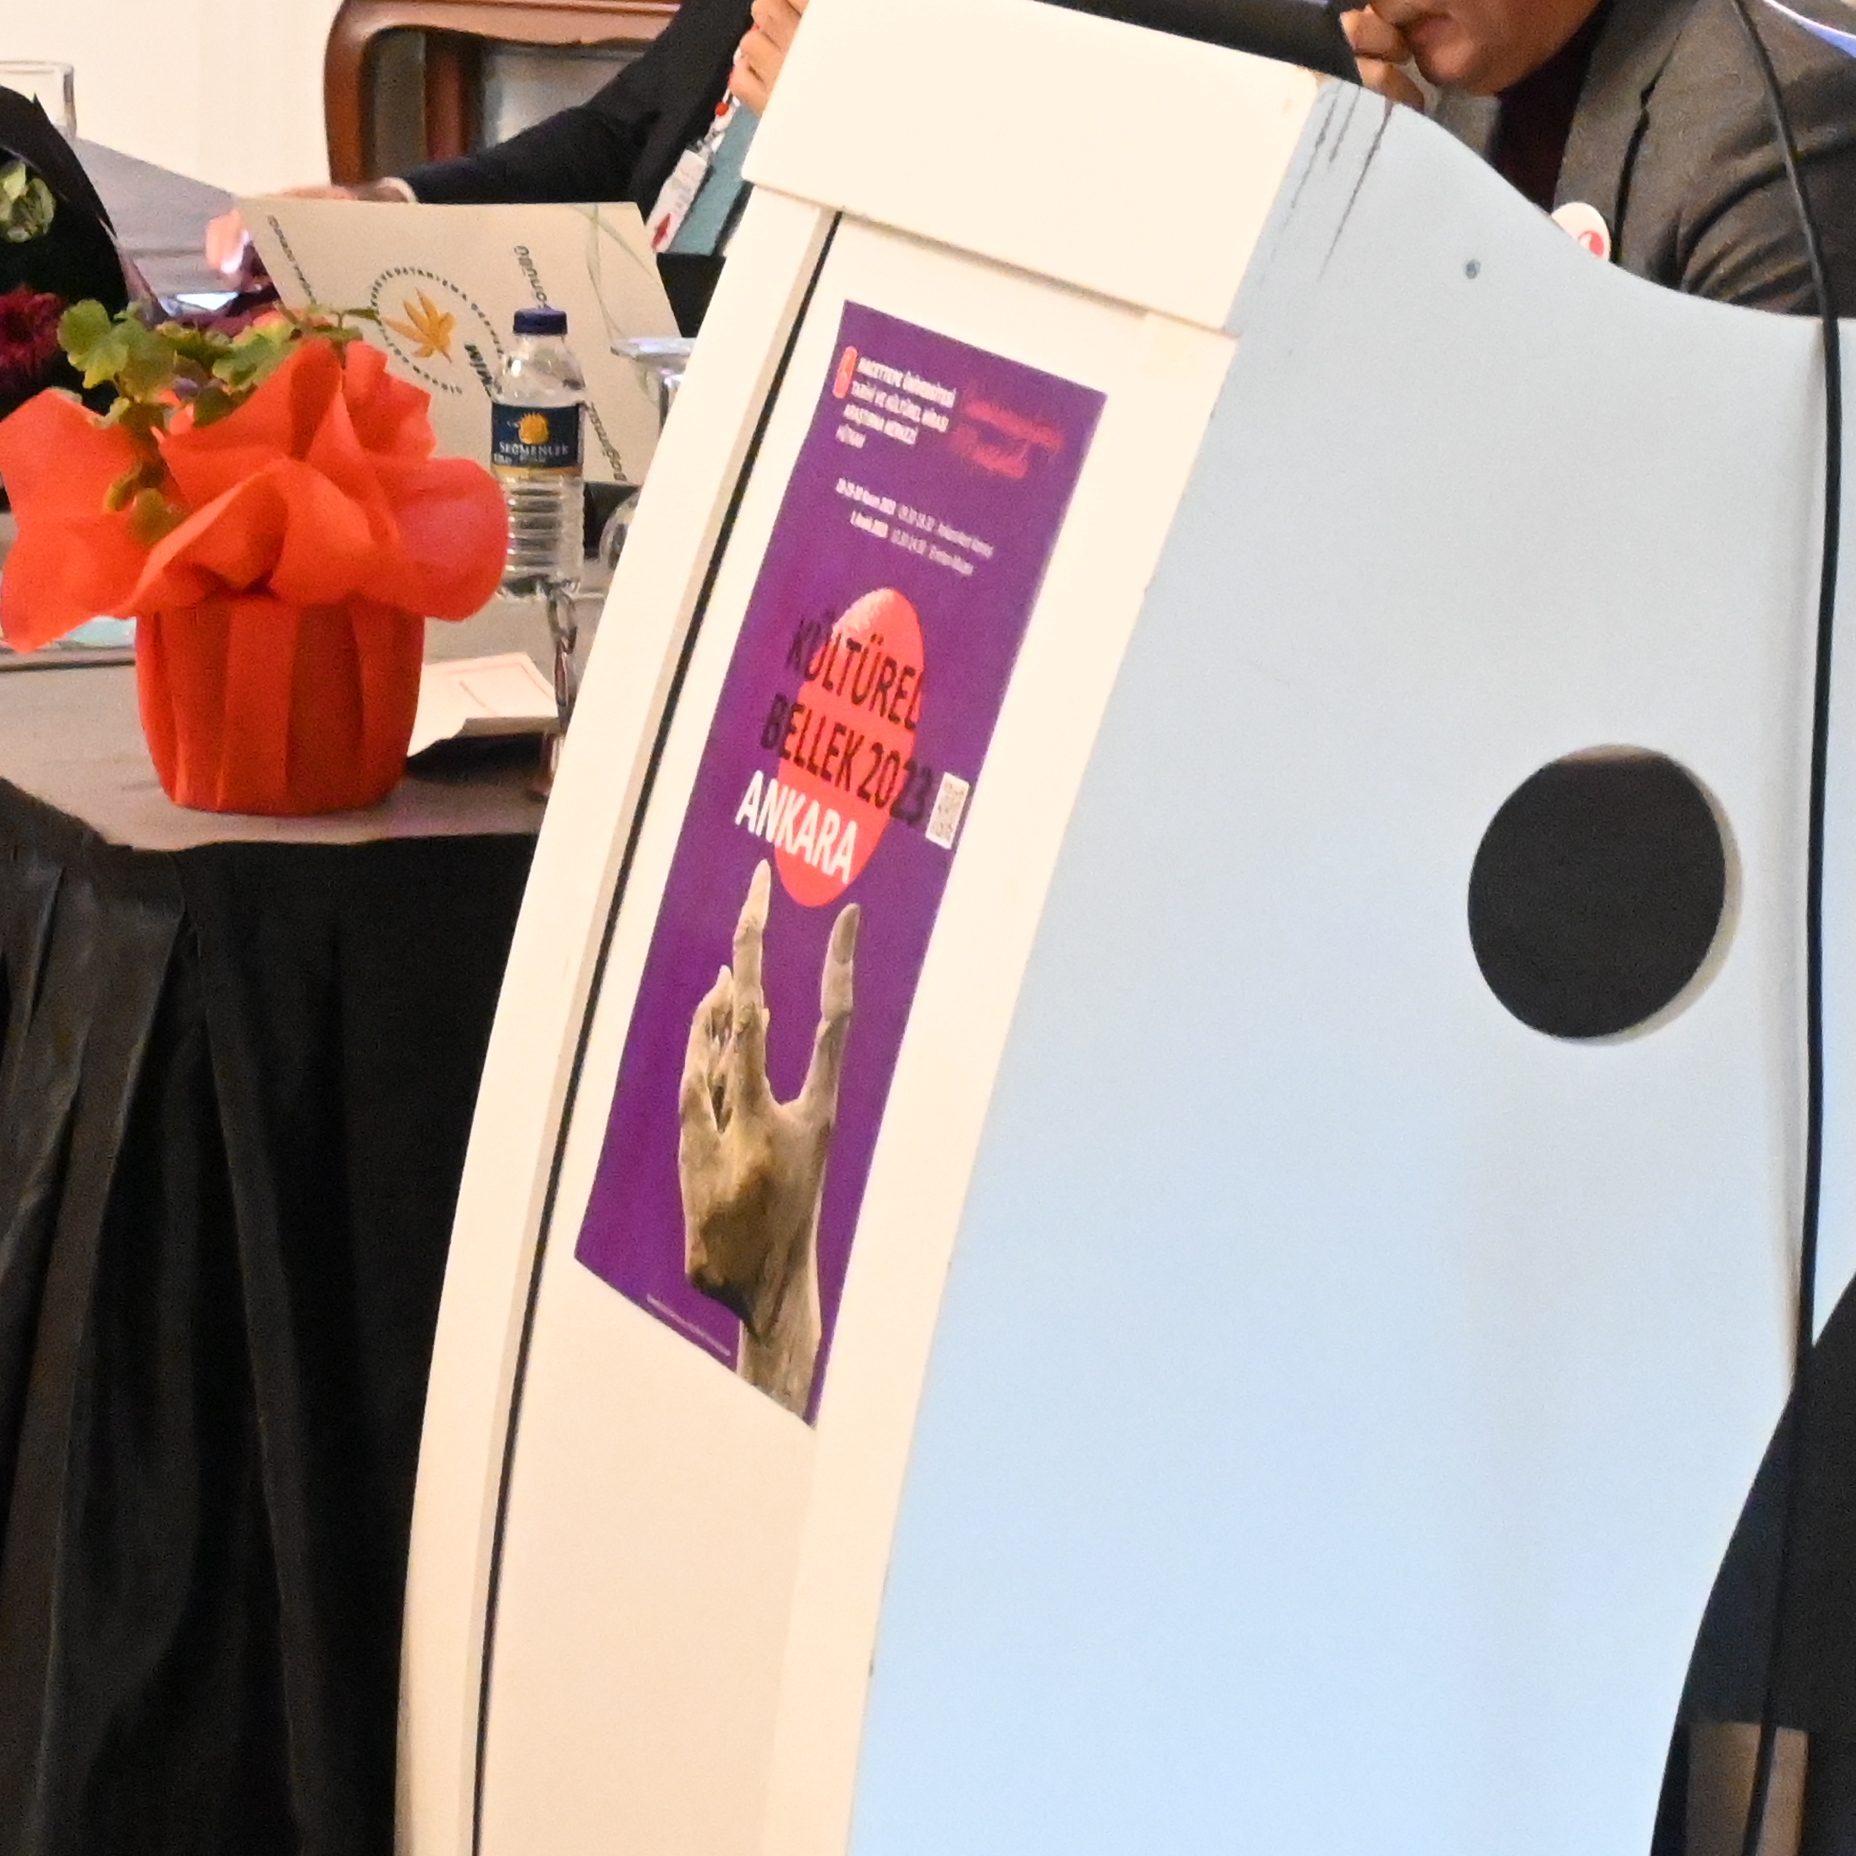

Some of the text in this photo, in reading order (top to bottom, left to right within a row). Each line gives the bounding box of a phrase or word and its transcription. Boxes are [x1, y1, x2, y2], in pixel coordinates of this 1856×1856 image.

[786, 609, 925, 731] KÜLTÜREL
[760, 693, 933, 826] BELLEK 2023
[735, 769, 857, 884] ANKARA
